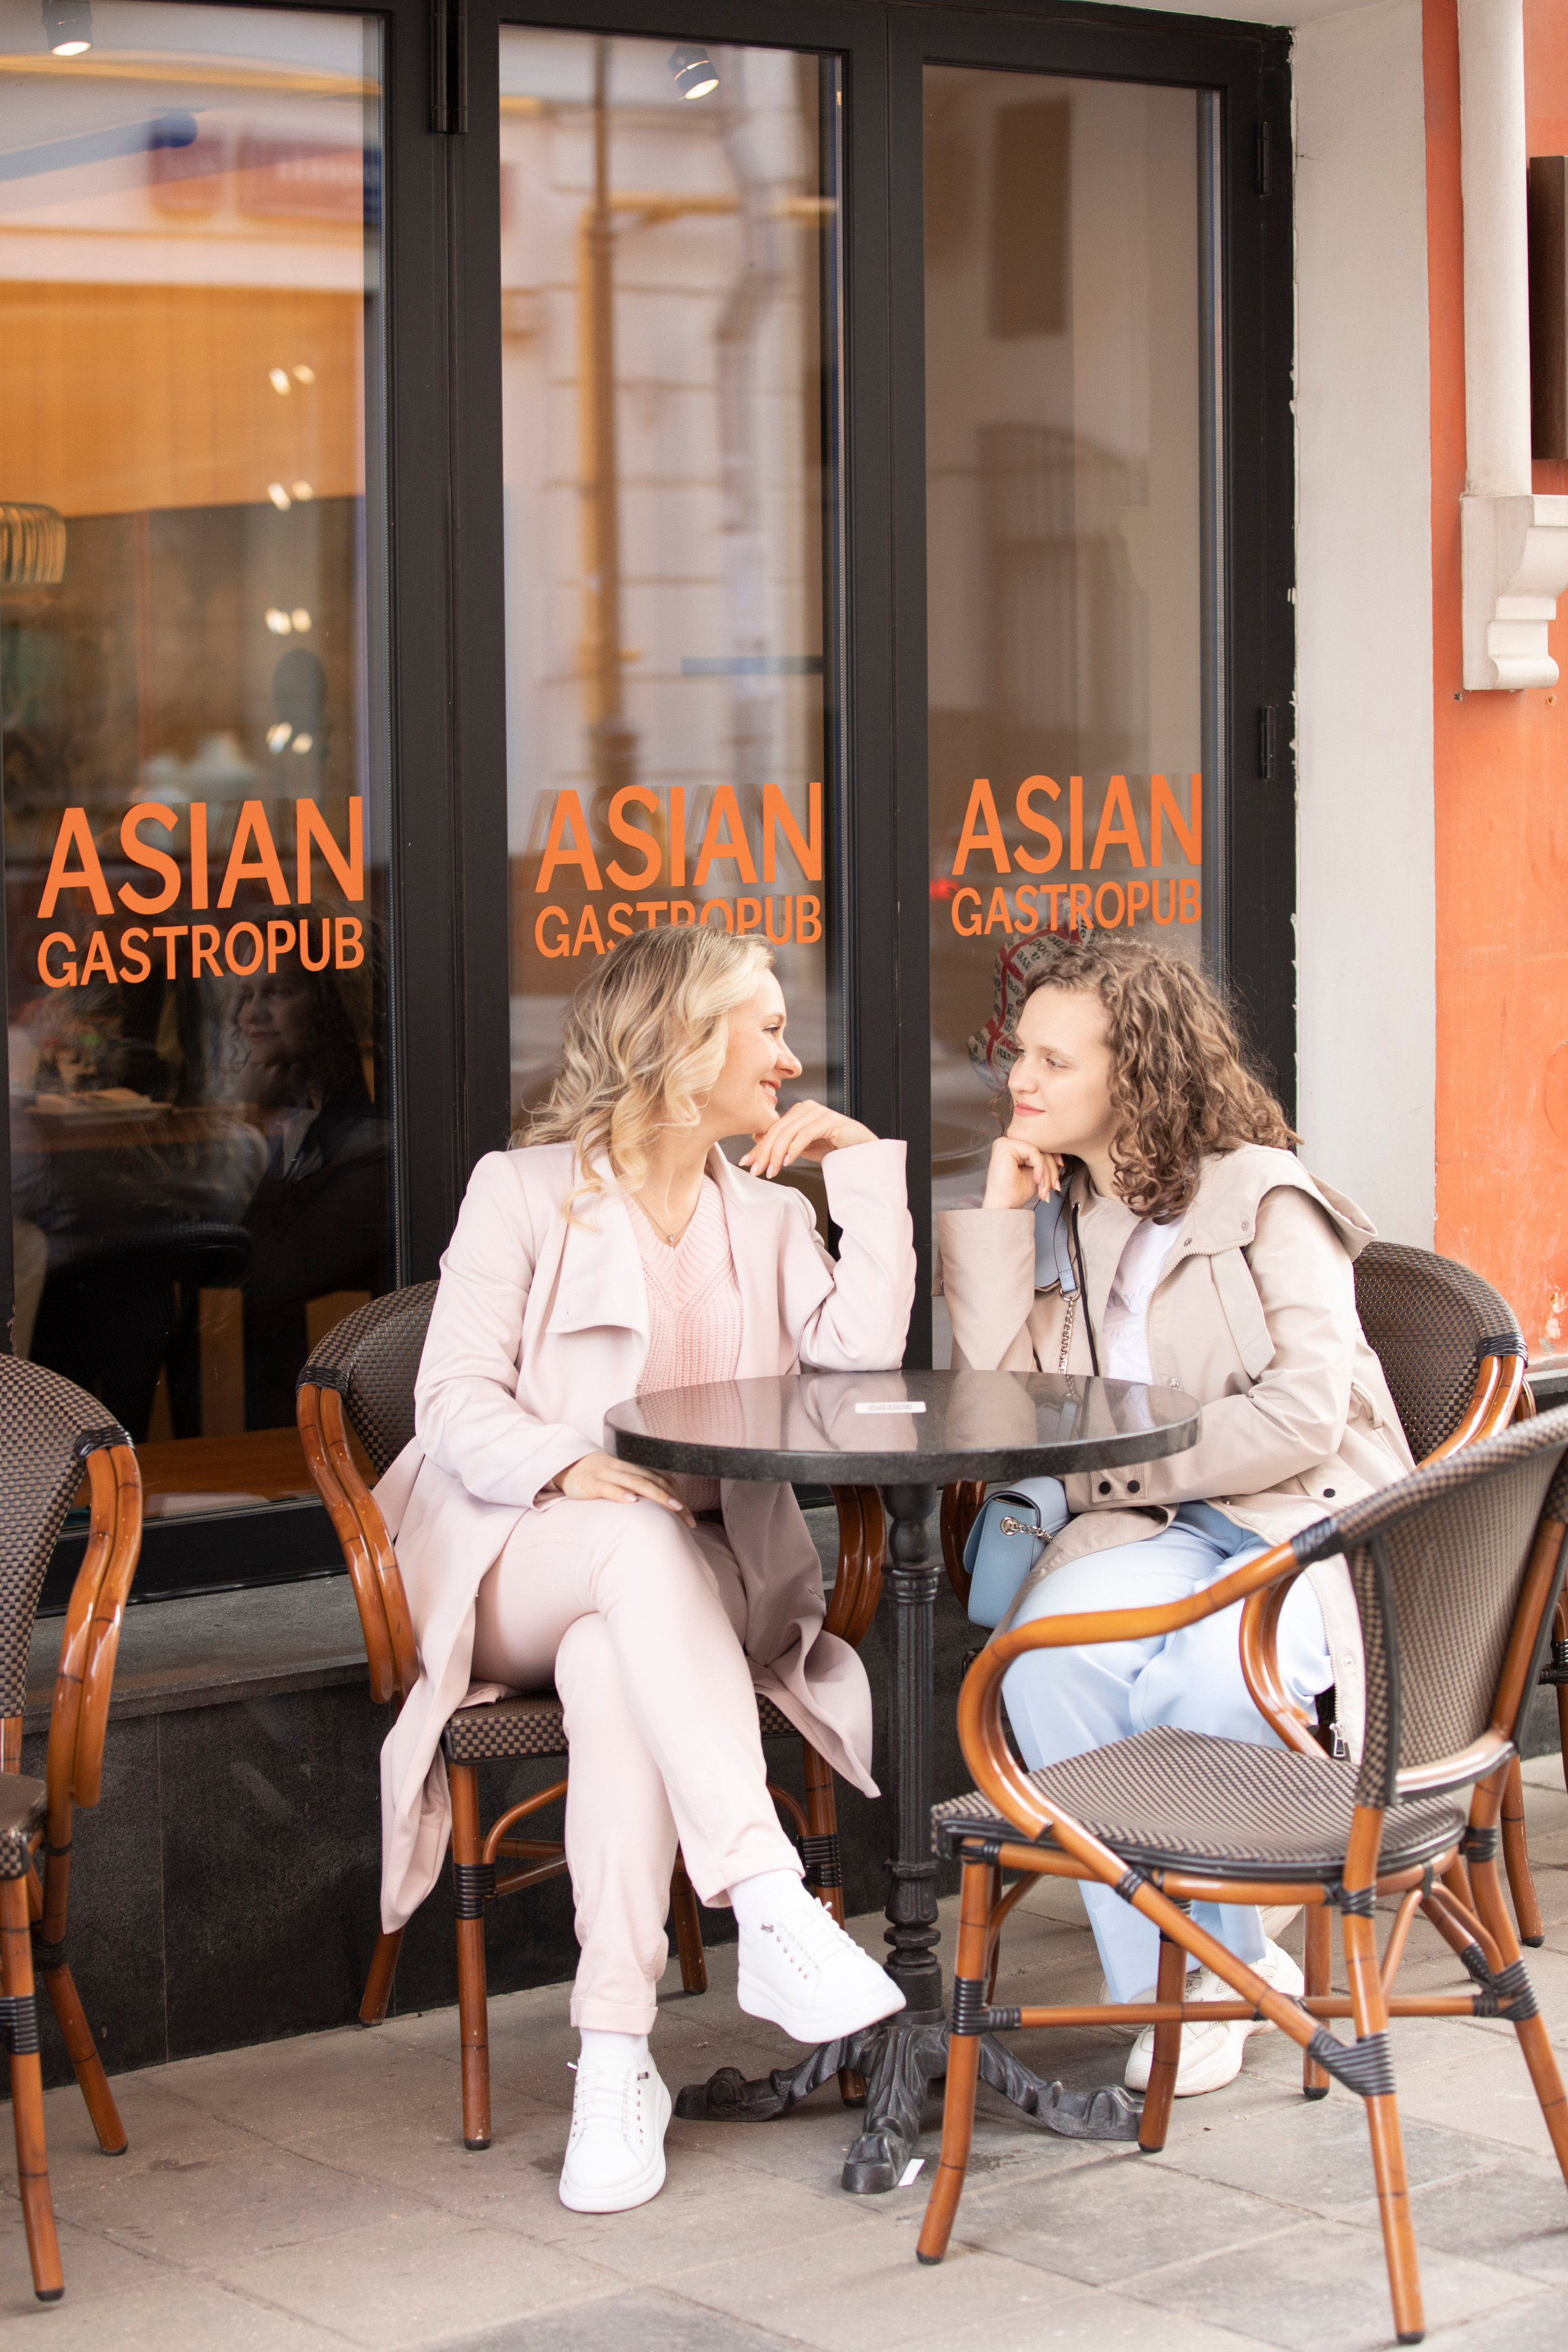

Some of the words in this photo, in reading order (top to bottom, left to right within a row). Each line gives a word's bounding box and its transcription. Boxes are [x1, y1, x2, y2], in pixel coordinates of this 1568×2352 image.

[37, 796, 364, 918] ASIAN
[535, 782, 822, 893] ASIAN
[952, 773, 1202, 875] ASIAN
[37, 916, 364, 988] GASTROPUB
[951, 878, 1202, 937] GASTROPUB
